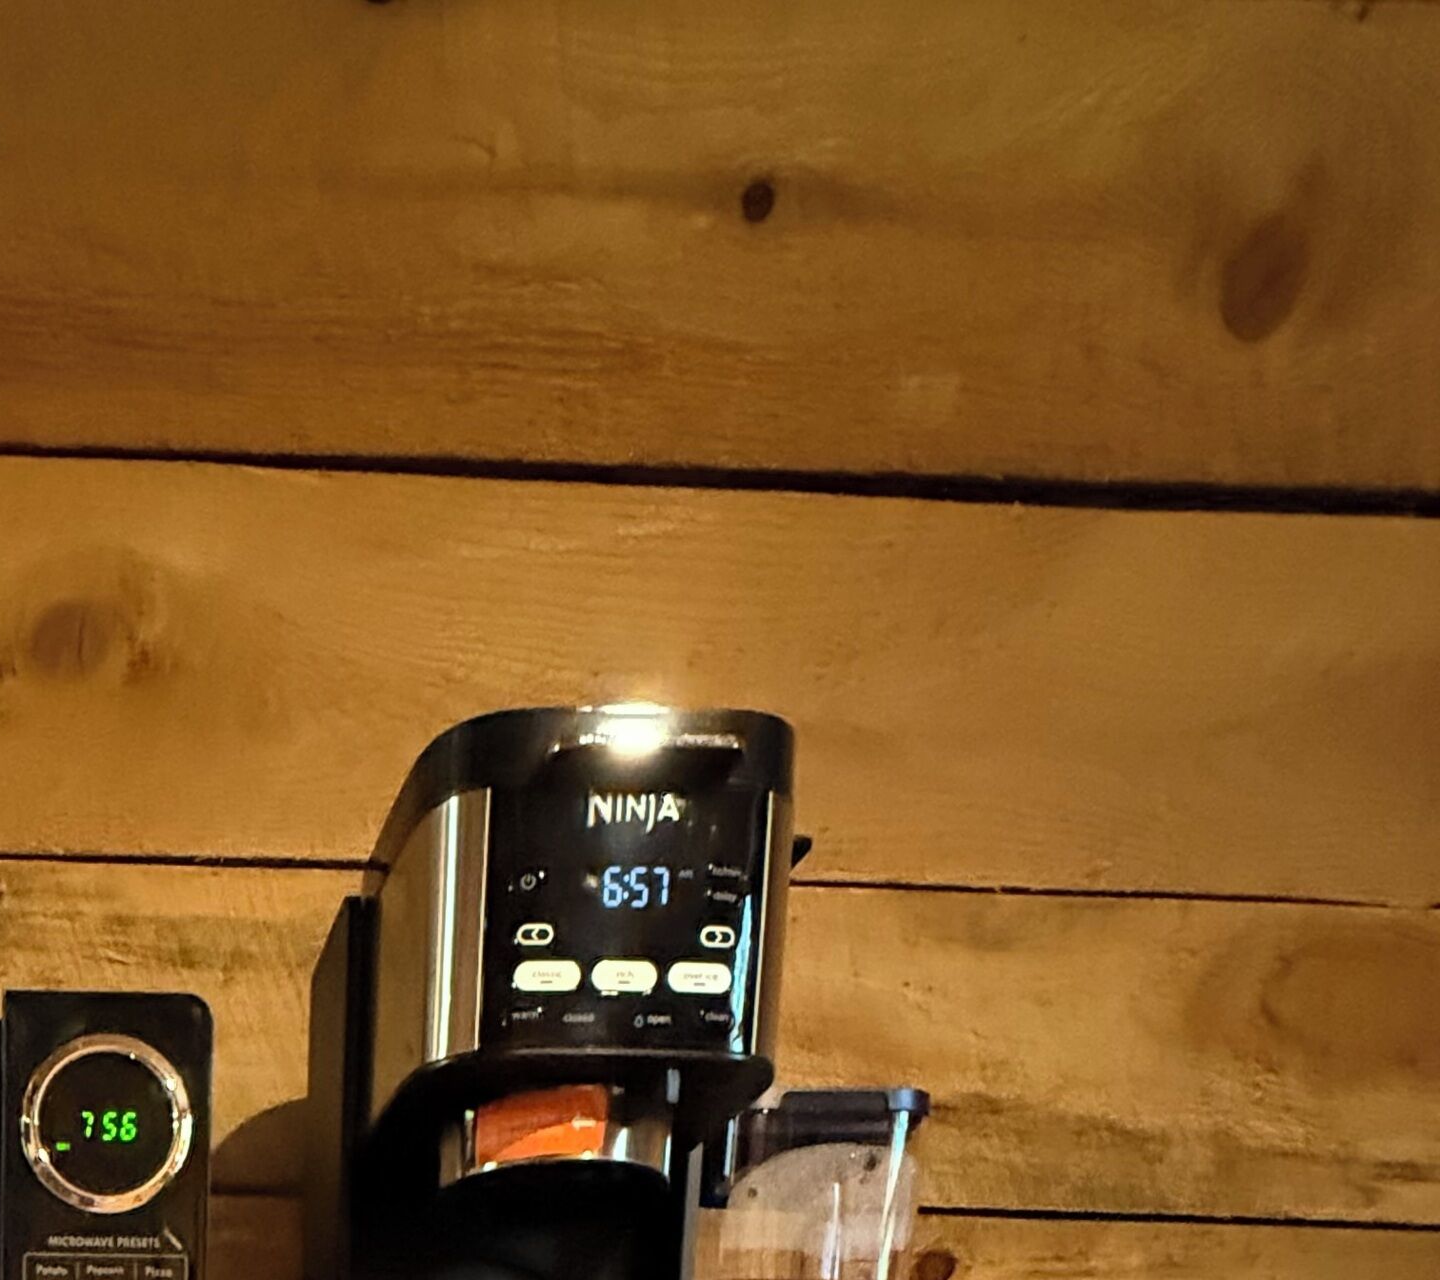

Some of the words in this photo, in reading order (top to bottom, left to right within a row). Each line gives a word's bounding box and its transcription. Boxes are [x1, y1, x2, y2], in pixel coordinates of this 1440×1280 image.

[586, 792, 680, 832] NINJA
[602, 865, 670, 909] 6:57
[48, 1235, 113, 1248] MICROWAVE
[117, 1236, 160, 1248] PRESETS
